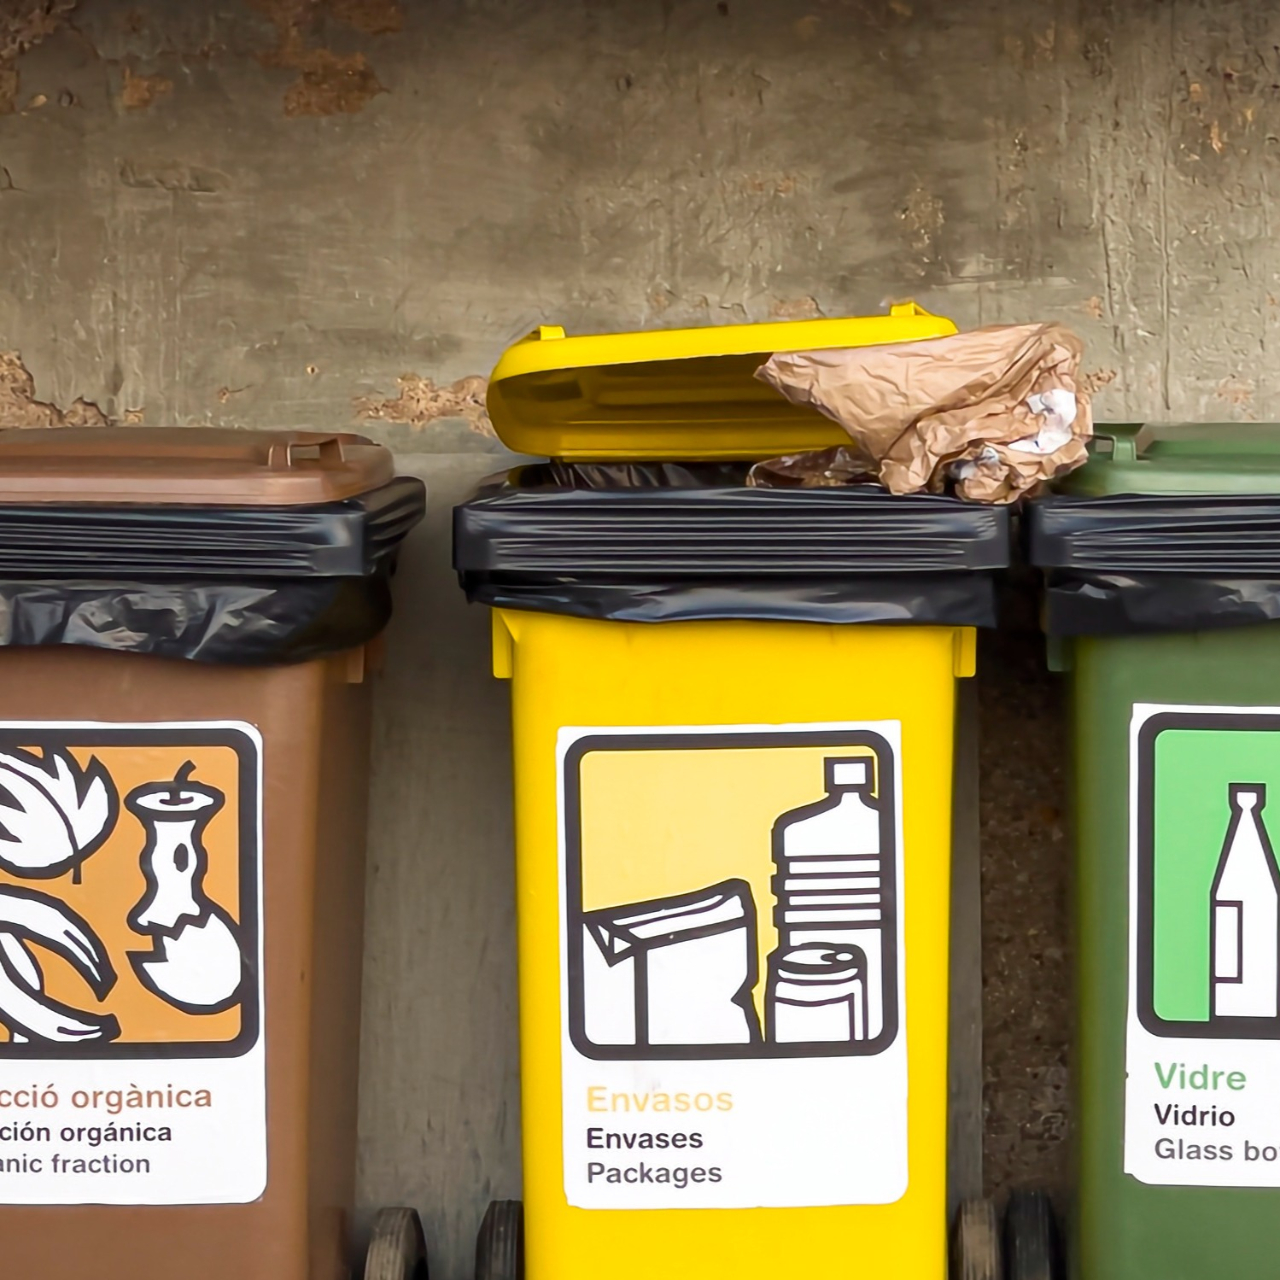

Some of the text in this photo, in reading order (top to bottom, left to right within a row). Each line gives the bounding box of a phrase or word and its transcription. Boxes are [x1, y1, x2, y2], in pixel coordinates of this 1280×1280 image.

[1154, 1061, 1247, 1091] Vidre
[0, 1083, 212, 1115] cció orgànica
[586, 1086, 734, 1112] Envasos
[1153, 1102, 1236, 1127] Vidrio
[0, 1121, 172, 1147] ción orgánica
[586, 1127, 704, 1149] Envases
[1154, 1137, 1234, 1161] Glass
[51, 1153, 150, 1174] fraction
[587, 1161, 723, 1189] Packages
